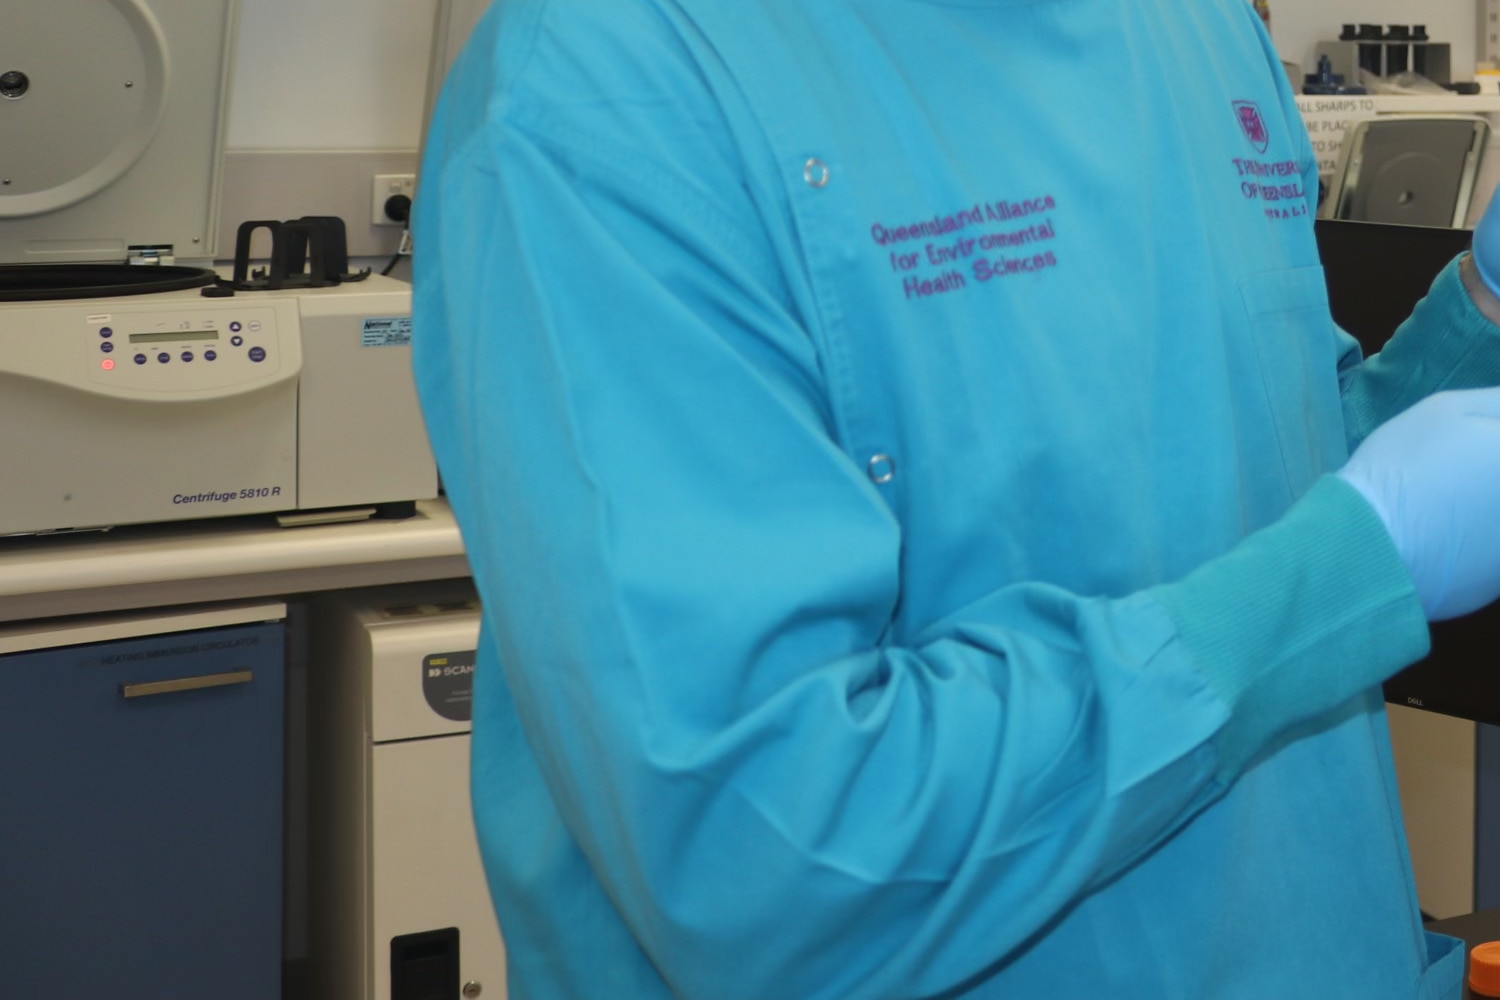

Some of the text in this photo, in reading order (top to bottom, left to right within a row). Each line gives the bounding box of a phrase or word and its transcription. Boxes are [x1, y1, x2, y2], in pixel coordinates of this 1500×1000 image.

[1359, 99, 1374, 110] TO
[1322, 120, 1349, 132] PLAC
[871, 195, 1056, 246] Queensland Alliance
[890, 251, 919, 272] for
[903, 270, 966, 300] Health
[173, 486, 281, 505] Centrifuge 5810 R
